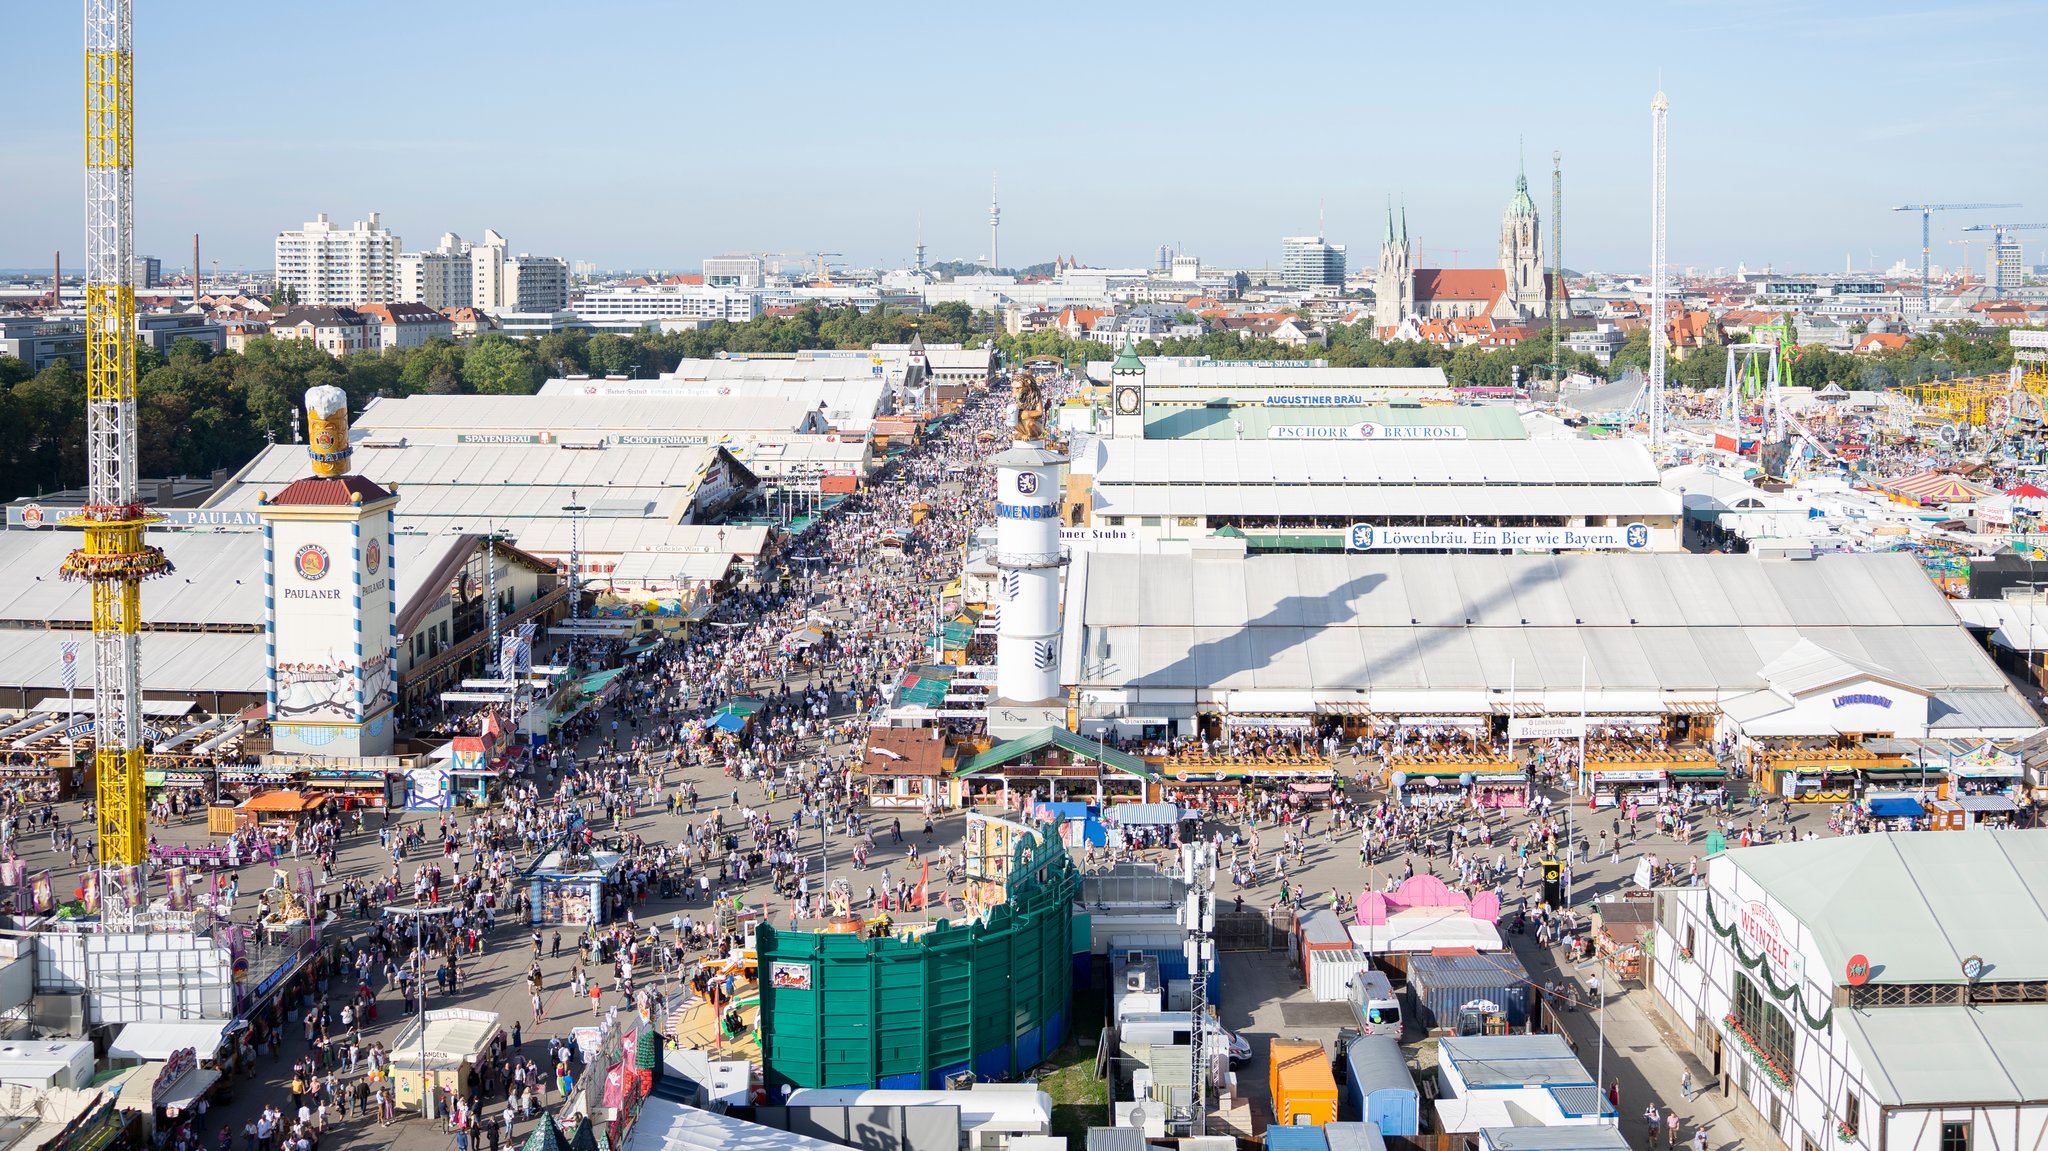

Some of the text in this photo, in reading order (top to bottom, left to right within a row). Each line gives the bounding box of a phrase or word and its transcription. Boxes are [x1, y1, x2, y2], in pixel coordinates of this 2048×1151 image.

[1230, 360, 1251, 368] raten,
[1266, 394, 1362, 404] AUGUSTINER BRÄU
[1278, 427, 1460, 437] PSCHORR BRÄUROSL
[464, 434, 531, 443] SPATENBRÄU
[622, 435, 707, 445] SCHOTTENHAMEL
[187, 511, 264, 525] PAULAN
[1092, 529, 1127, 539] Stubn
[1383, 531, 1619, 548] Löwenbräu. Ein Bier wie Bayern.
[296, 544, 329, 559] PAULANER
[362, 578, 386, 597] PAULANER
[284, 588, 342, 600] PAULANER
[1832, 693, 1894, 709] LÖWENBRÄU
[1521, 726, 1574, 737] Biergarten
[1750, 903, 1779, 938] KUFFLERS
[1740, 907, 1790, 970] WEINZELT
